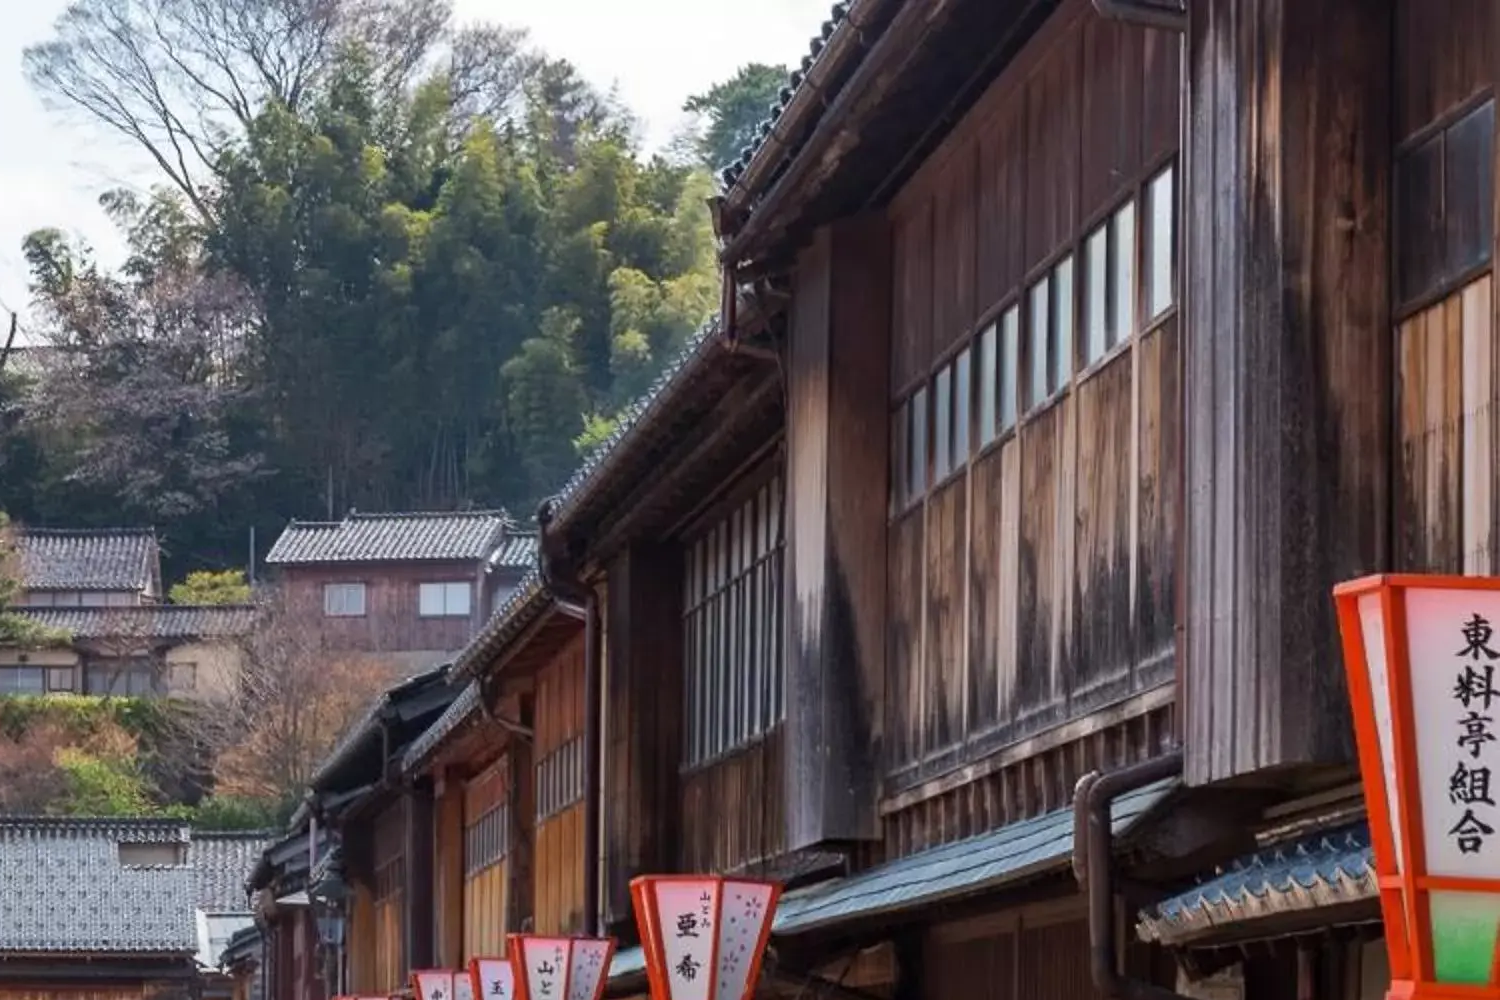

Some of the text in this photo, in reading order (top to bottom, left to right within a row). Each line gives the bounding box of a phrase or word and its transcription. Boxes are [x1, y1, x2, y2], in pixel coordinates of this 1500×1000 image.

[1447, 612, 1500, 855] 東料亭組合
